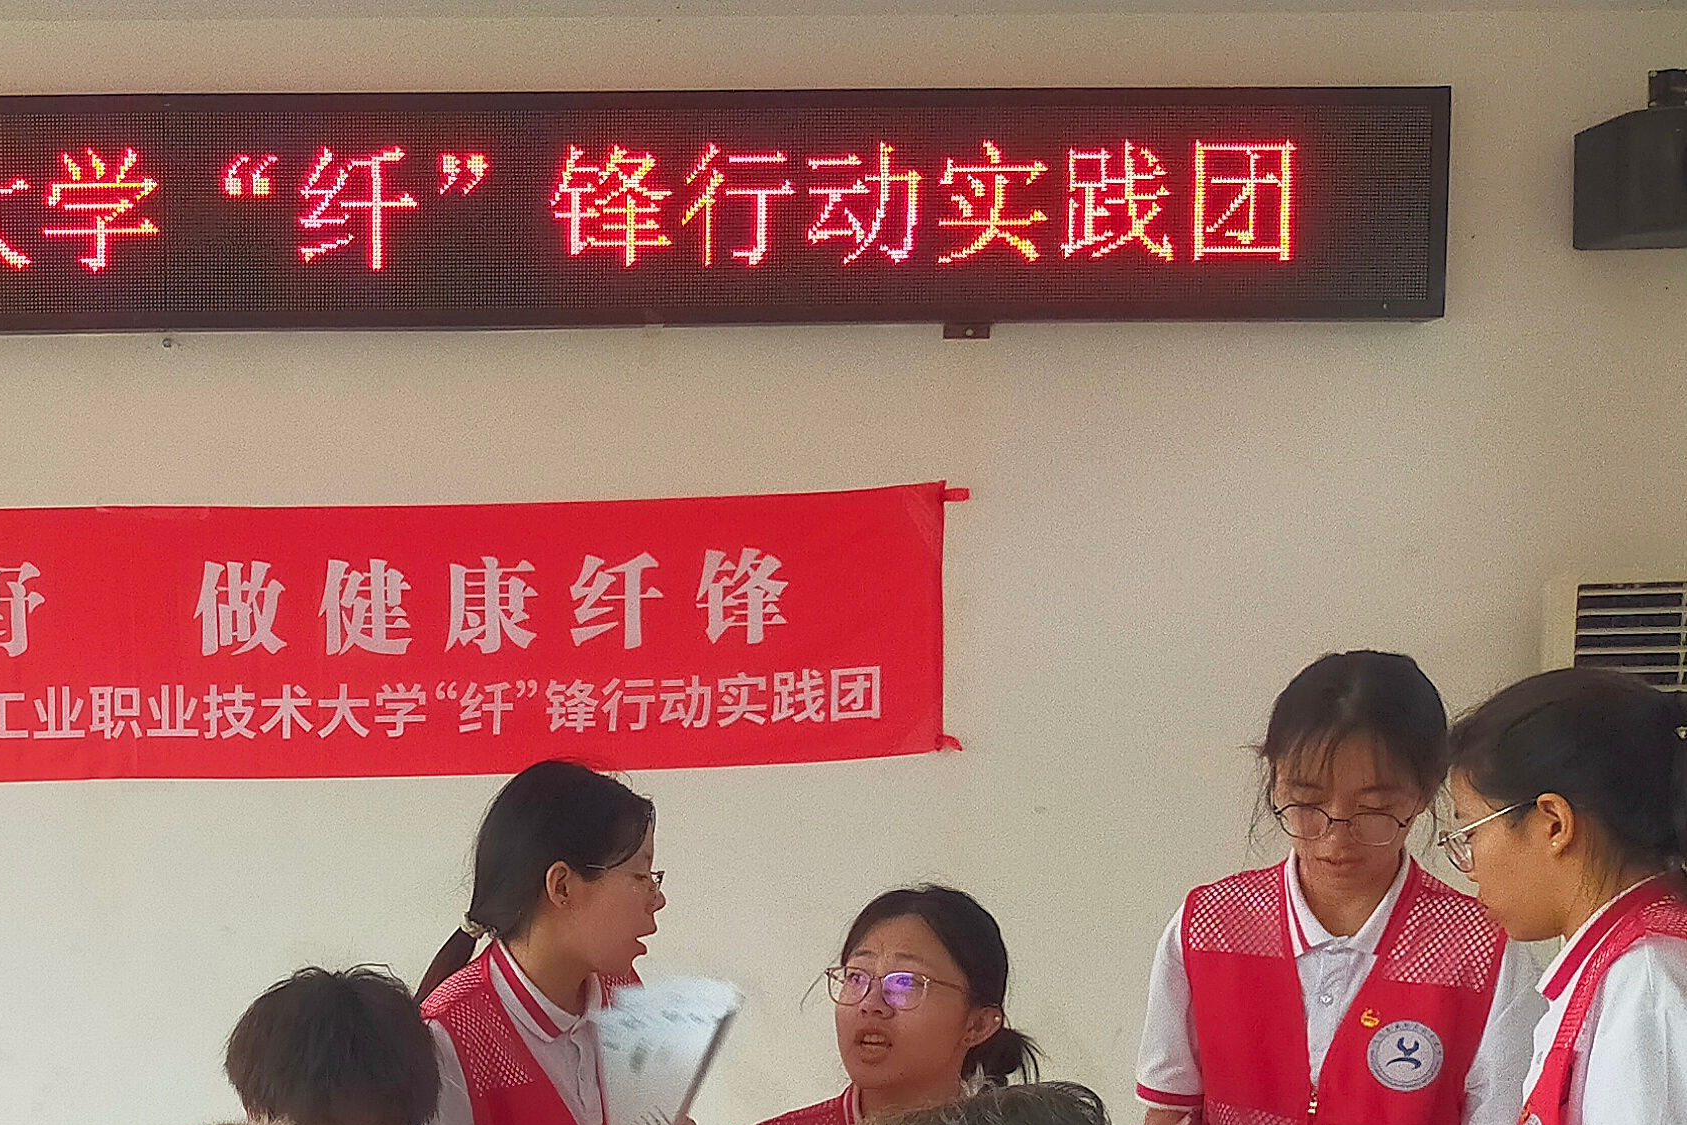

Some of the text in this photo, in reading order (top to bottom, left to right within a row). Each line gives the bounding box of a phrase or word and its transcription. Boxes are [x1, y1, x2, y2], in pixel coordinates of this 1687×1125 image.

[193, 548, 789, 656] 做健康纤锋
